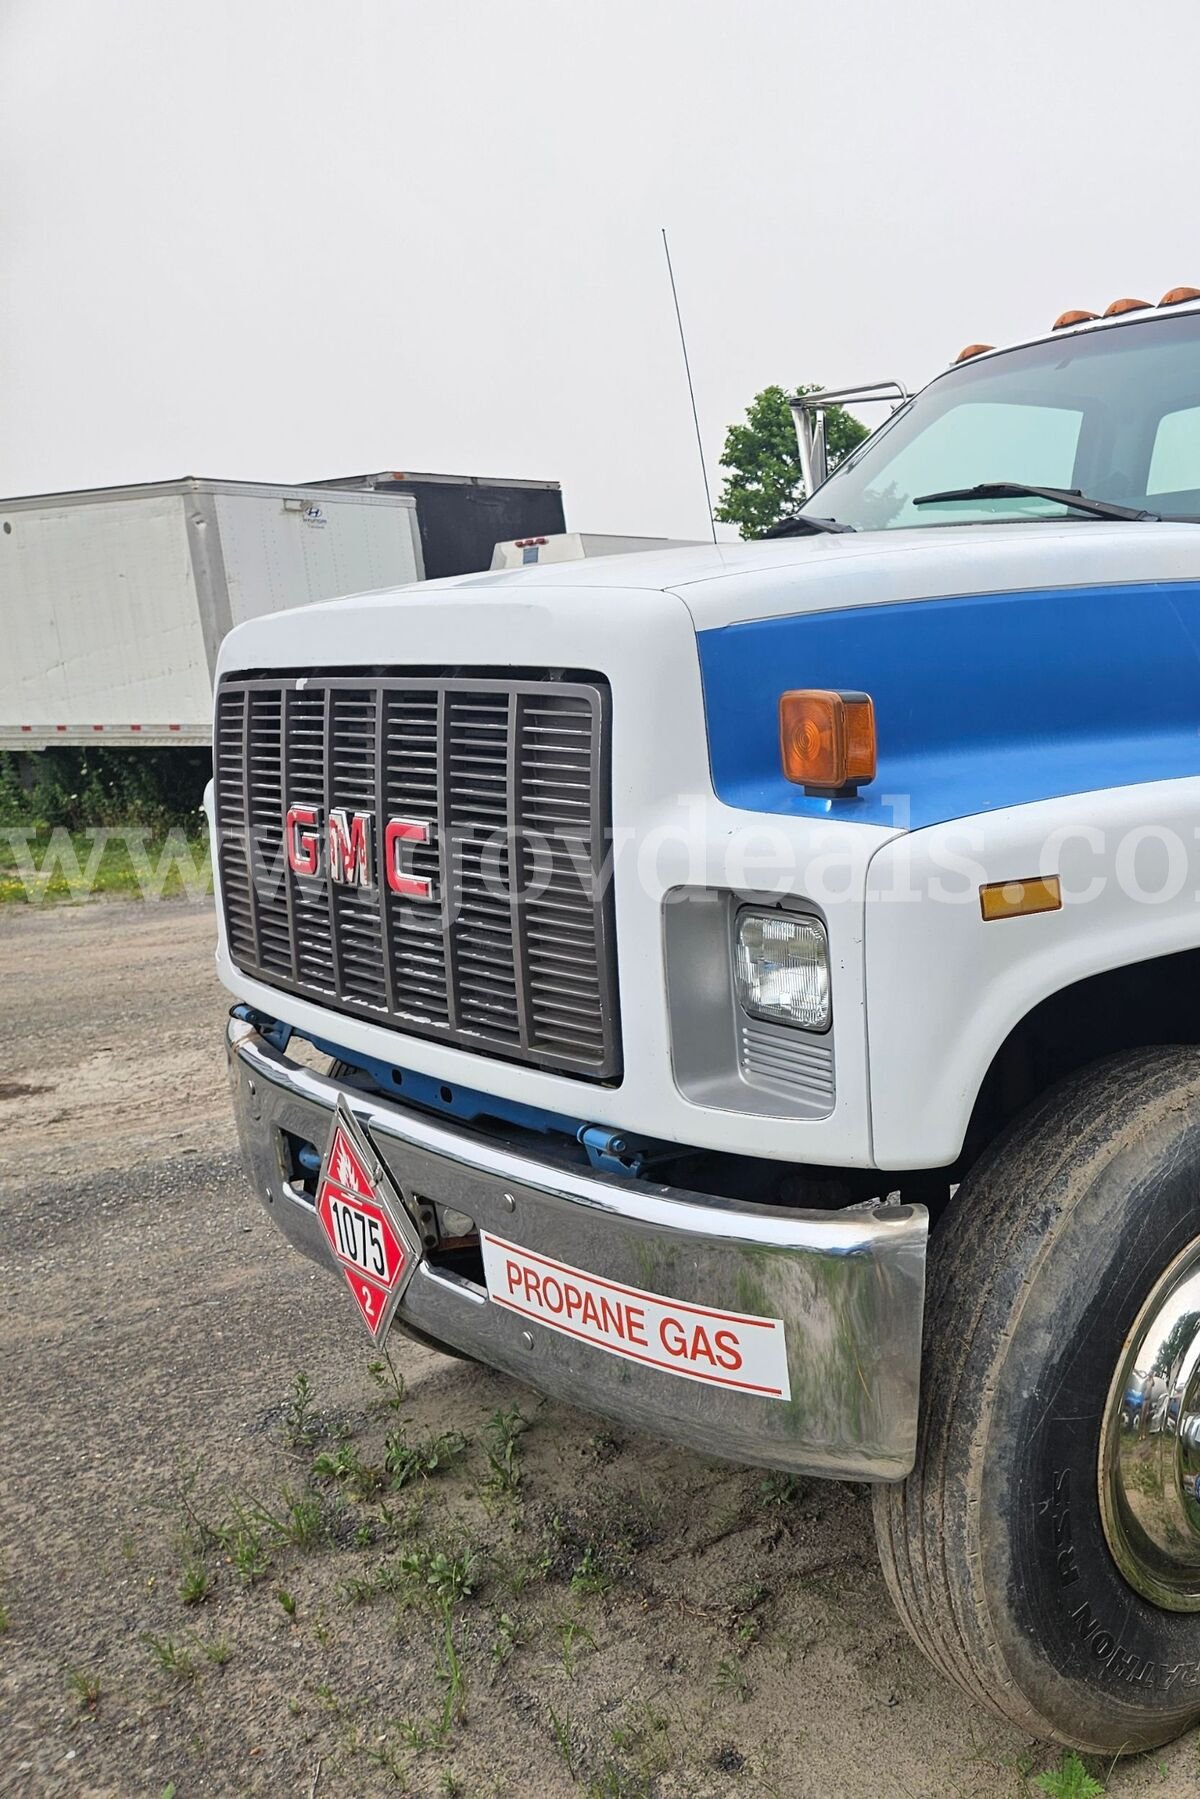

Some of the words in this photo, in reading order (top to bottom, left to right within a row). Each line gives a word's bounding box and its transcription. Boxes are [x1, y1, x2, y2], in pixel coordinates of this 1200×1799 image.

[286, 803, 434, 901] GMC
[332, 1201, 385, 1277] 1075
[361, 1285, 375, 1316] 2
[506, 1259, 649, 1347] PROPANE
[659, 1317, 743, 1371] GAS
